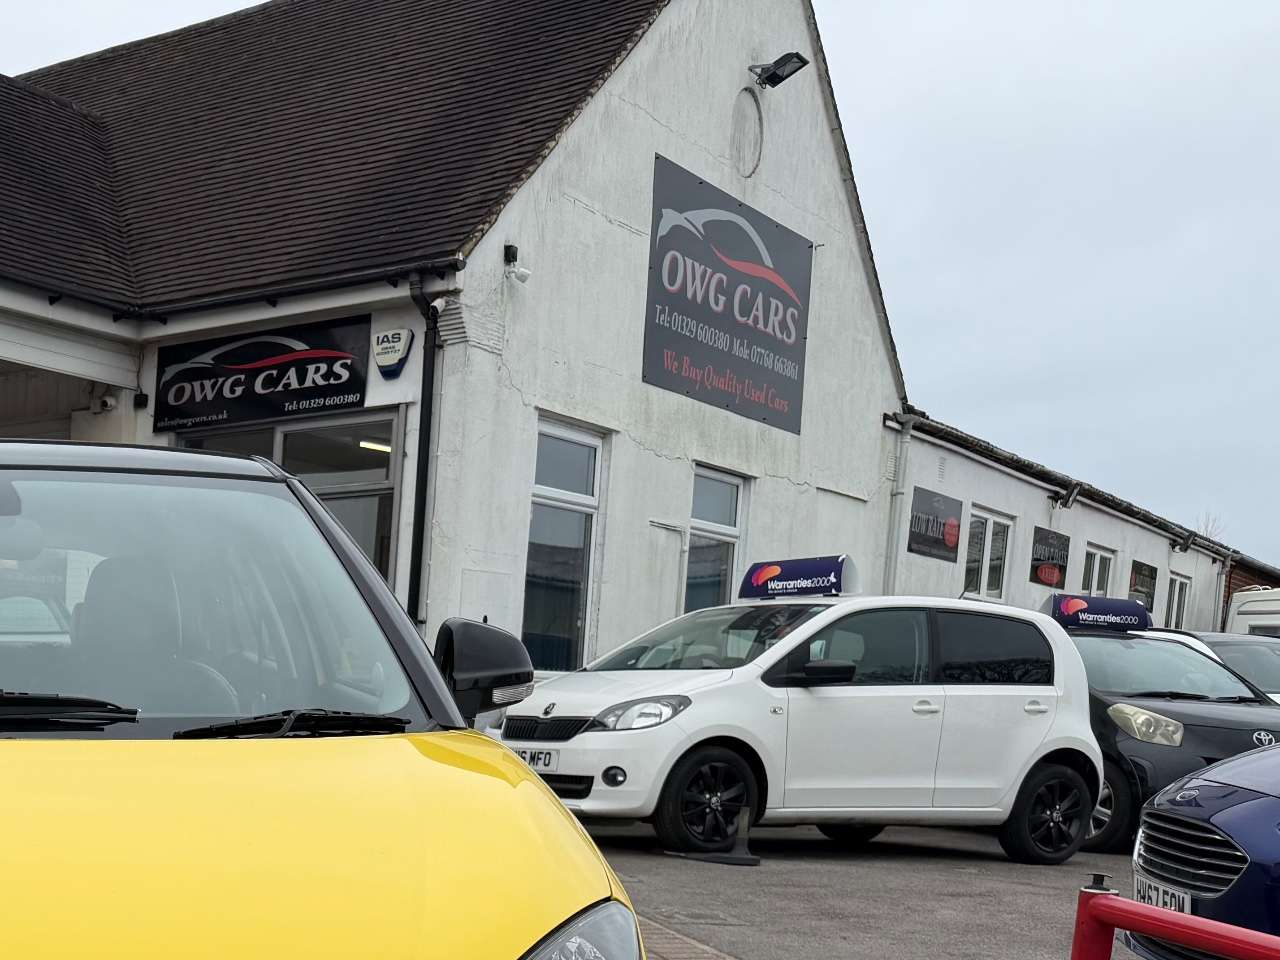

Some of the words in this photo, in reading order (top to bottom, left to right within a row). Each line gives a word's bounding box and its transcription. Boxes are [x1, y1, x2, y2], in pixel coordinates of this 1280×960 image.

[661, 250, 728, 314] OWG
[733, 283, 799, 345] CARS
[376, 333, 401, 346] IAS
[655, 304, 670, 328] Tel:
[671, 313, 697, 339] 01329
[697, 322, 730, 352] 600380
[731, 336, 750, 361] Mob:
[750, 344, 774, 370] 07768
[167, 374, 246, 406] OWG
[254, 359, 352, 395] CARS
[663, 349, 679, 375] We
[681, 355, 704, 387] Buy
[704, 365, 743, 404] Quality
[743, 381, 766, 404] Used
[768, 389, 790, 414] Cars
[284, 402, 298, 412] Tel:
[299, 398, 324, 410] 01329
[325, 393, 361, 406] 600380
[767, 576, 831, 590] Warranties2000
[1078, 612, 1139, 625] Warranties2000
[528, 751, 552, 767] MFO
